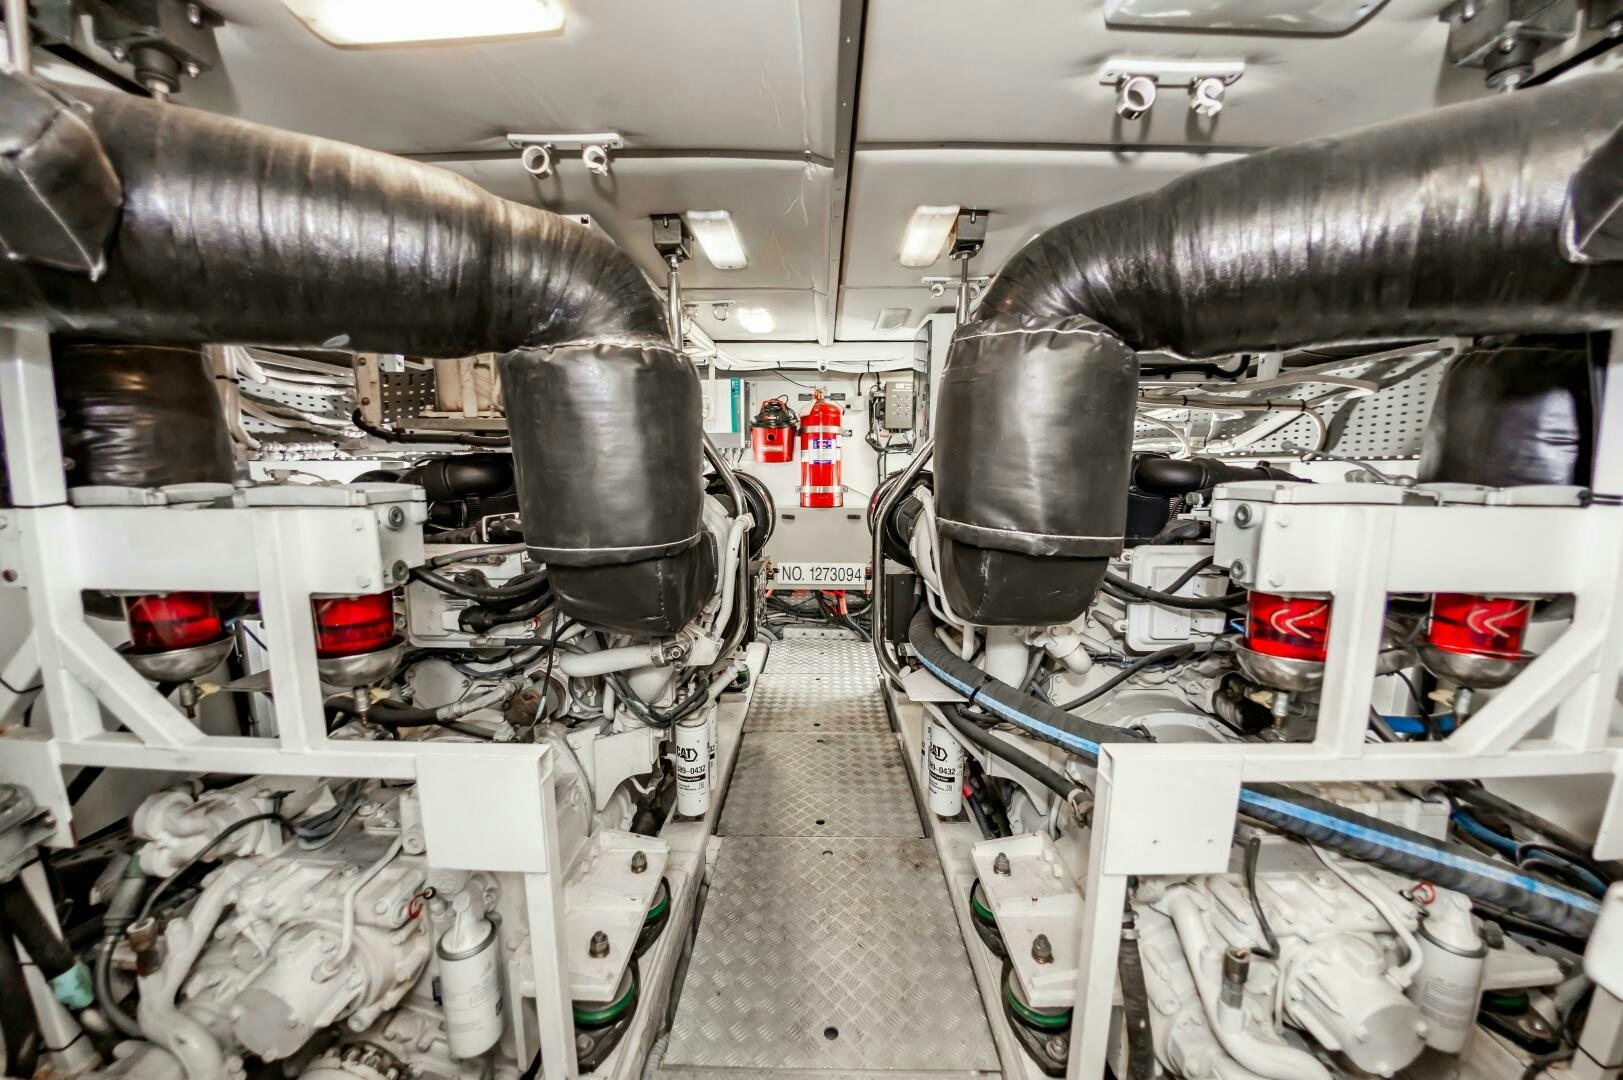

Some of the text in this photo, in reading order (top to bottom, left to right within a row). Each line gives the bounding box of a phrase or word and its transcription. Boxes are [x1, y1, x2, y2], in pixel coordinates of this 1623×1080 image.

[782, 566, 861, 582] NO. 1273094
[677, 745, 696, 762] CAT
[930, 761, 956, 775] 9-0432
